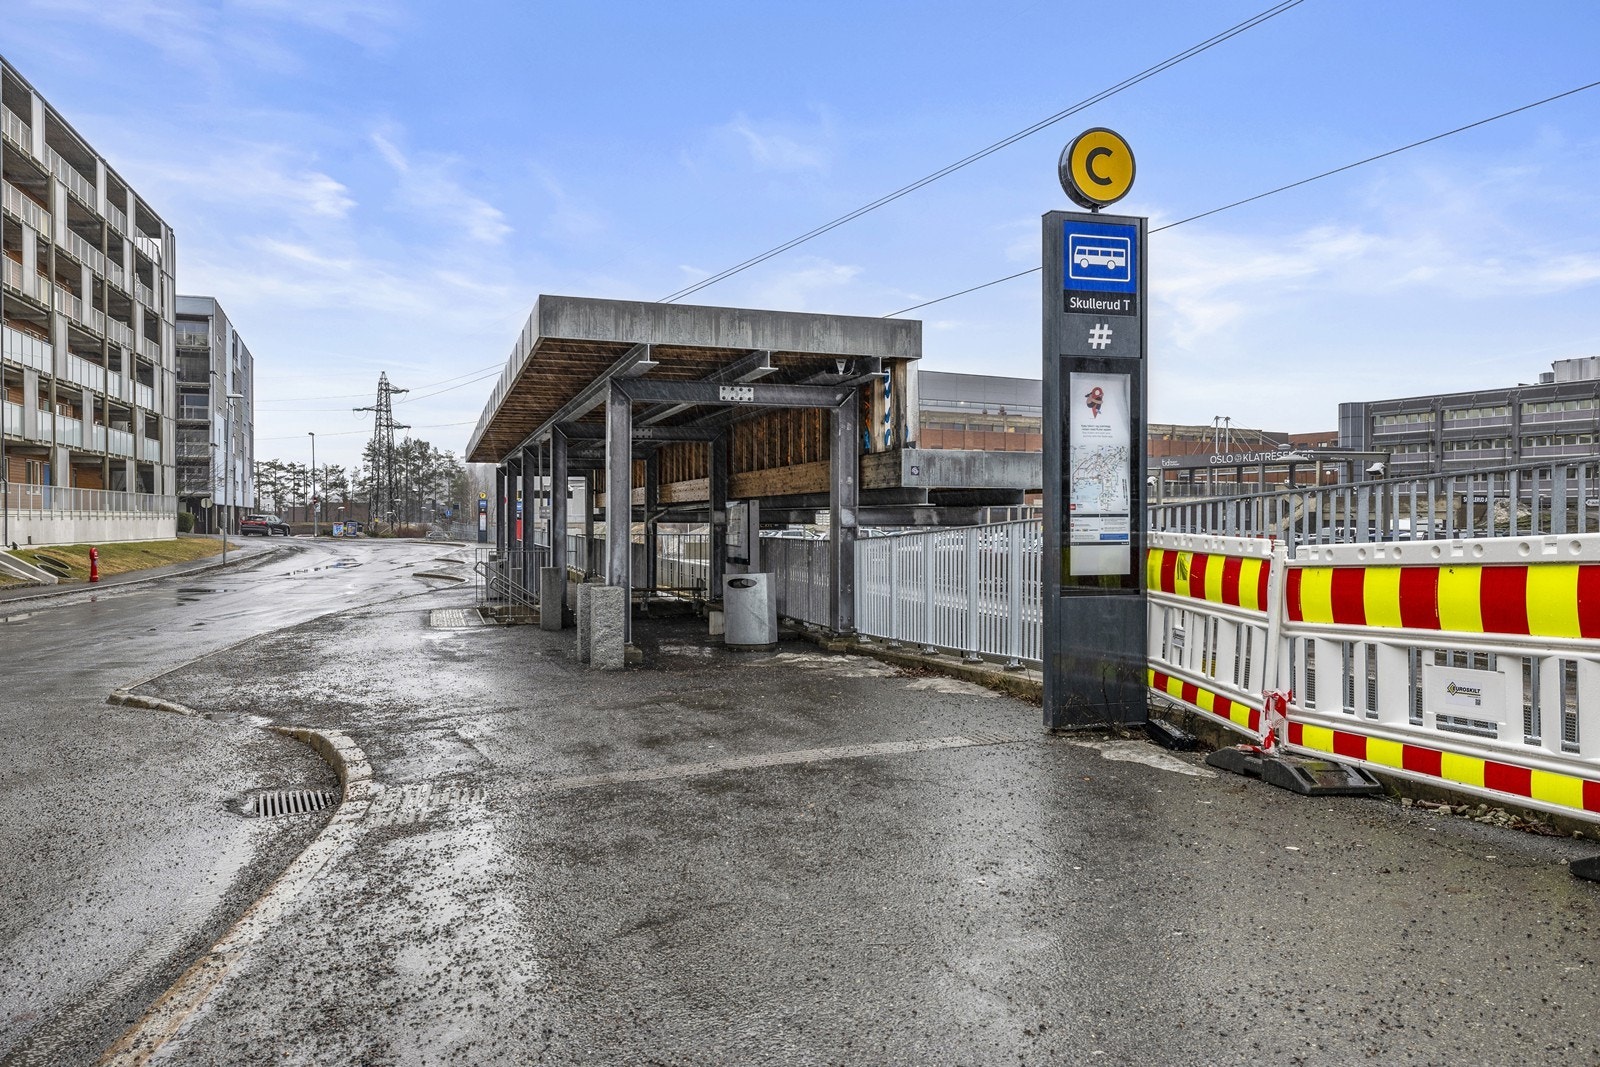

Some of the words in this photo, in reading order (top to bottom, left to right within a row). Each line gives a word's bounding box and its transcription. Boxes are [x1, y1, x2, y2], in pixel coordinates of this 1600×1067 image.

[1085, 146, 1113, 186] C
[1070, 296, 1120, 310] Skullerud
[1122, 299, 1130, 311] T
[1088, 323, 1113, 349] #
[1209, 454, 1233, 464] OSLO
